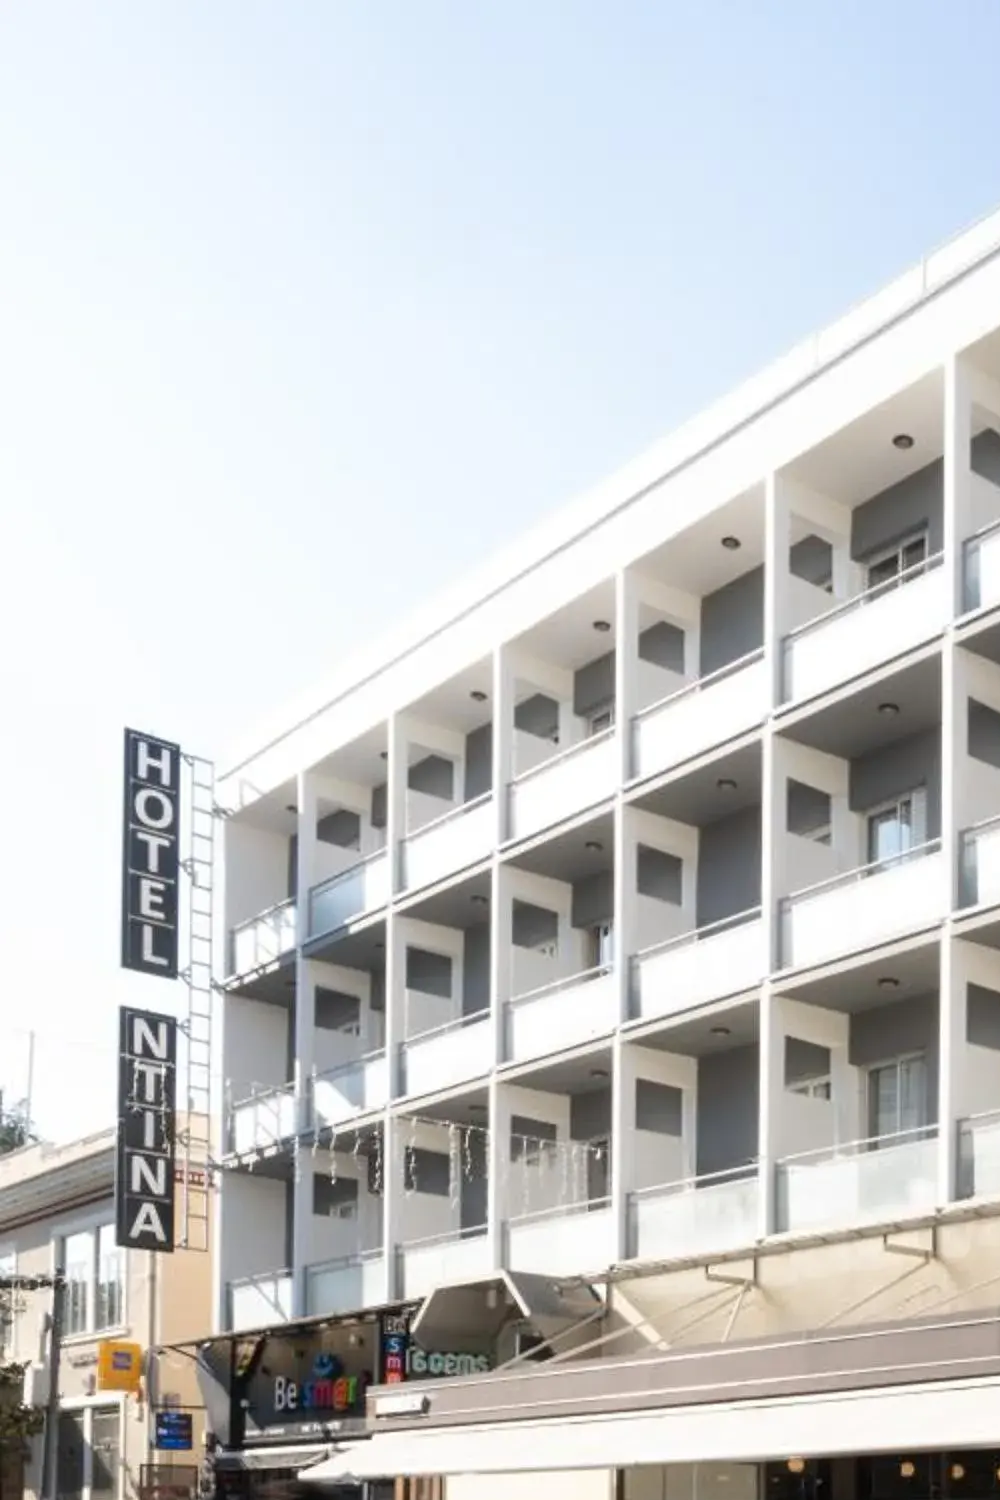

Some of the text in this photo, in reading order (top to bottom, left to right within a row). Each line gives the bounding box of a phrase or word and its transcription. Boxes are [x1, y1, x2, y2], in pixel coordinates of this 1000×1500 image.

[132, 740, 175, 967] HOTEL
[129, 1018, 169, 1242] NTINA
[274, 1375, 297, 1411] Be
